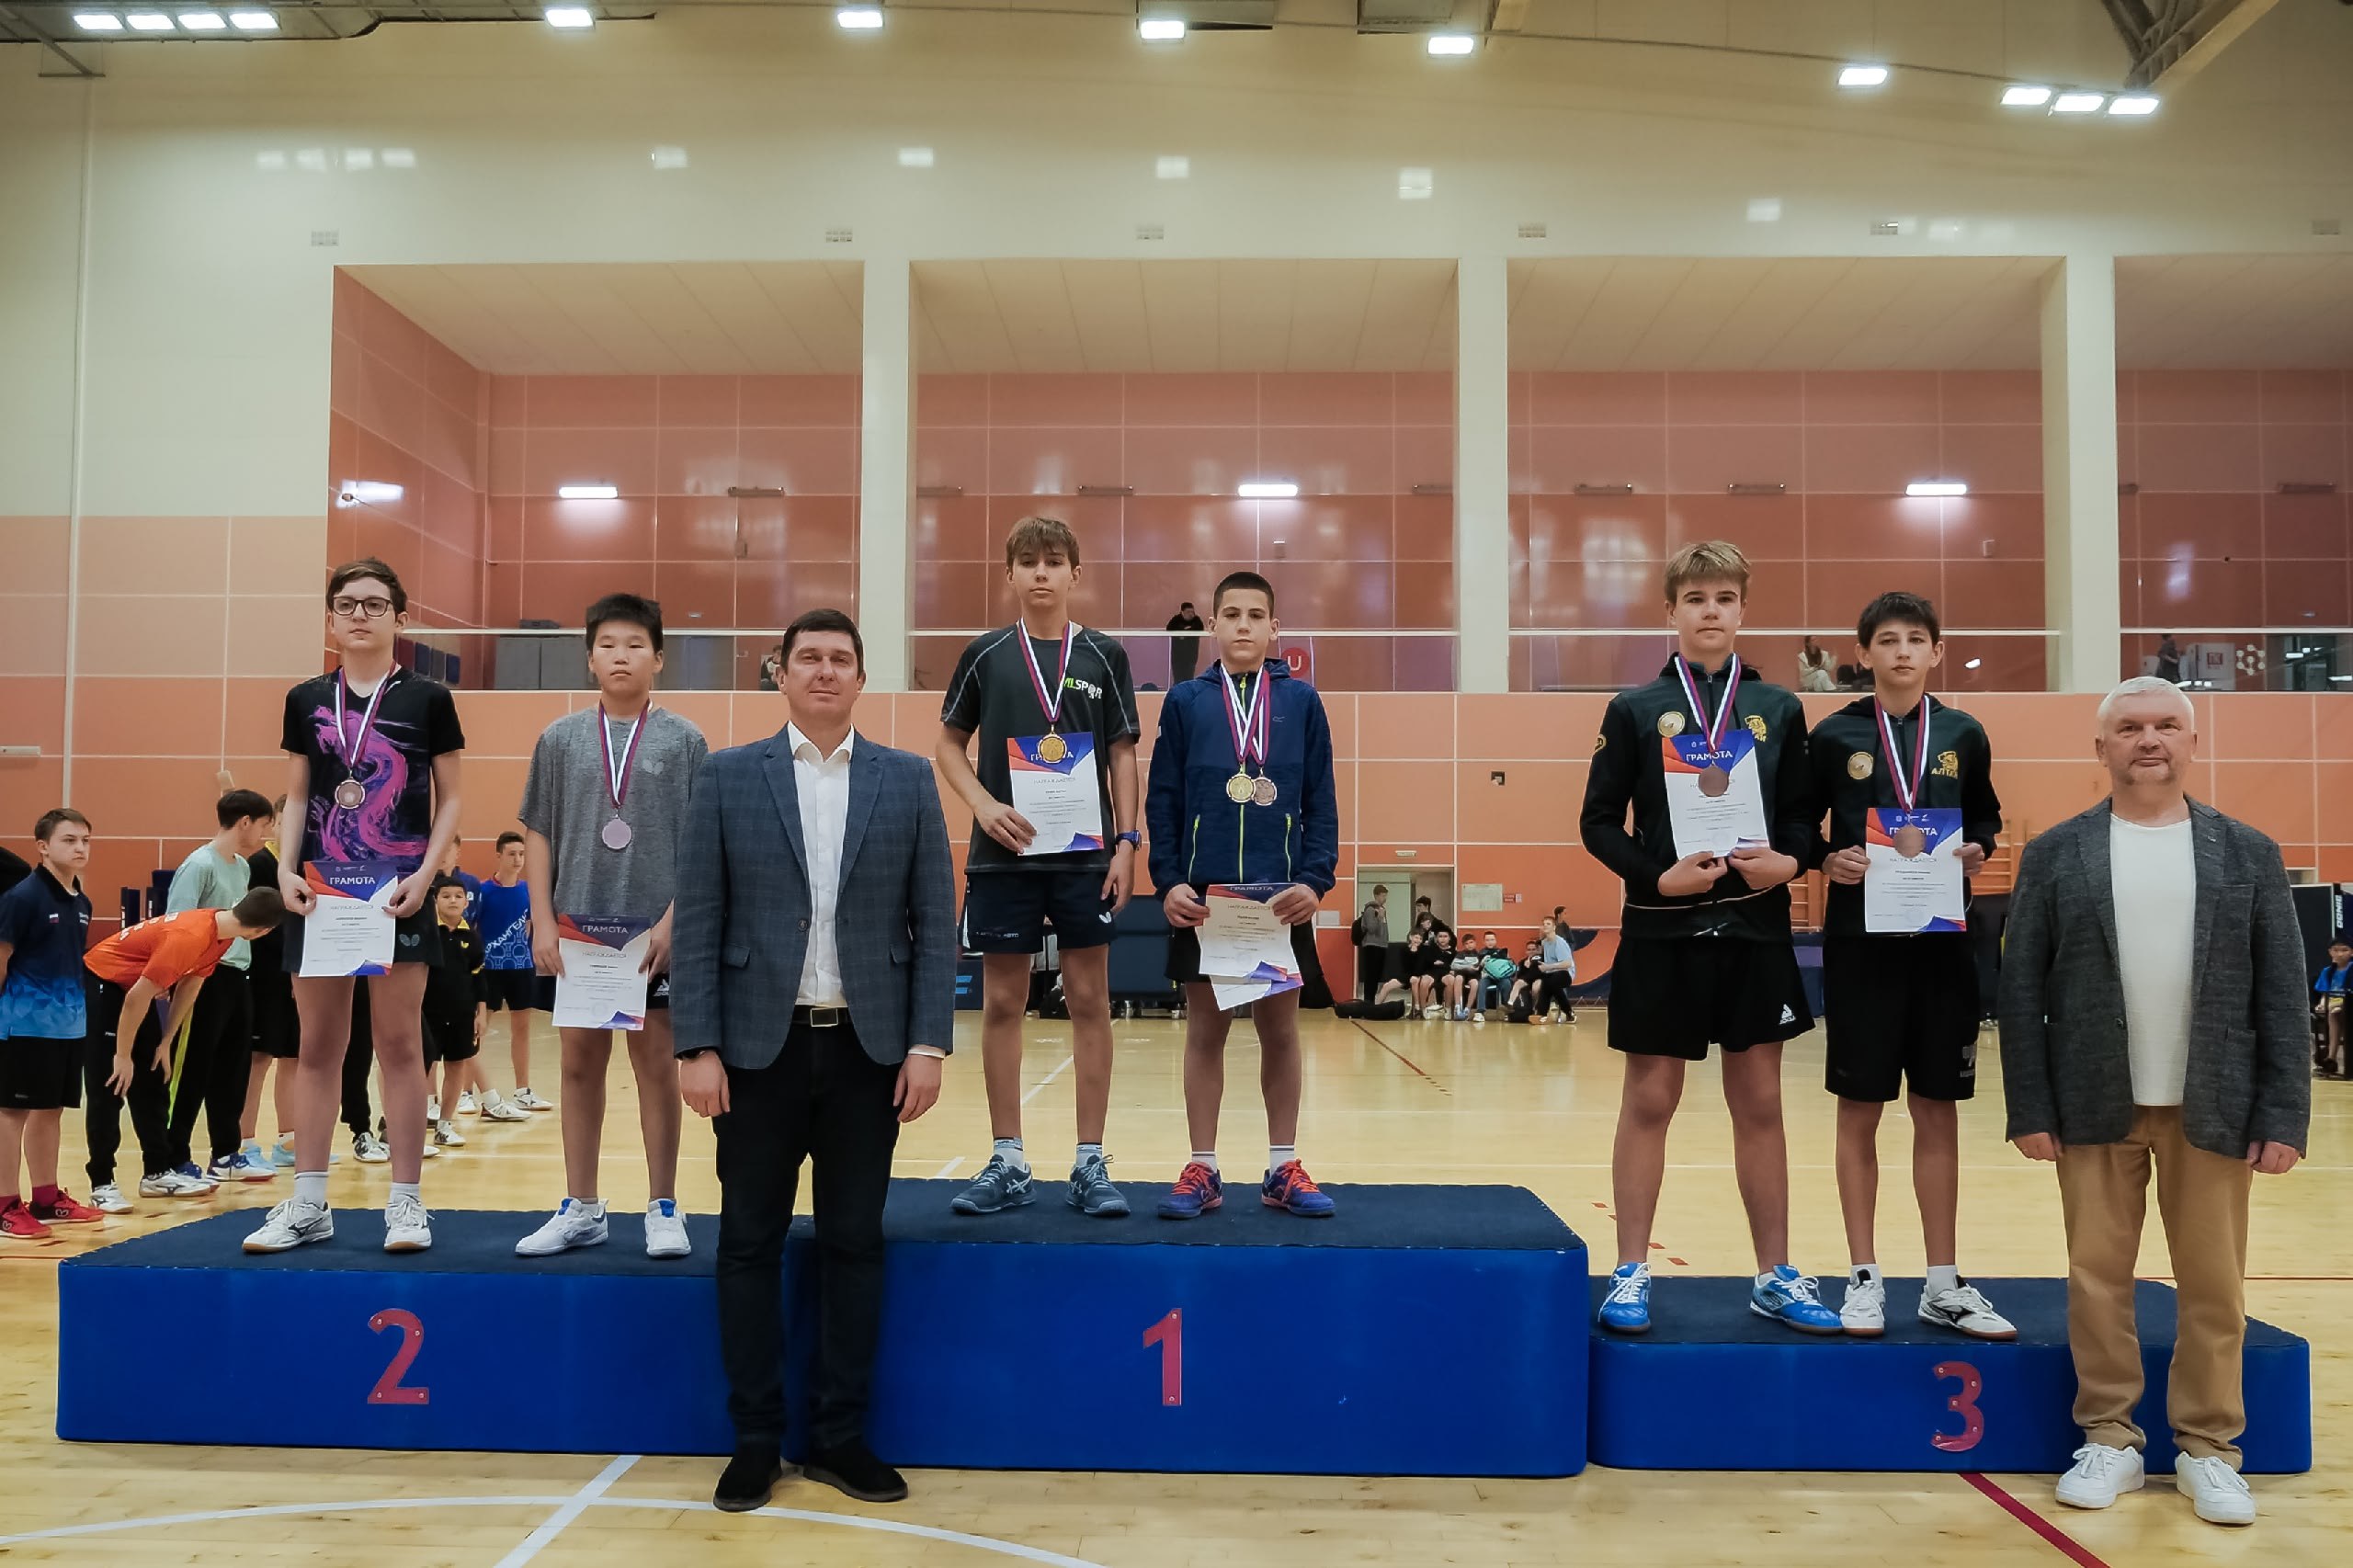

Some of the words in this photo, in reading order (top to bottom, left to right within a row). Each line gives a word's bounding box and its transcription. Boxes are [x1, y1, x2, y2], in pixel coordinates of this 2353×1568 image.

[1686, 750, 1733, 762] ГРАМОТА
[329, 876, 376, 885] ГРАМОТА
[582, 925, 629, 934] ГРАМОТА
[368, 1308, 429, 1404] 2
[1142, 1308, 1182, 1406] 1
[1931, 1361, 1984, 1452] 3
